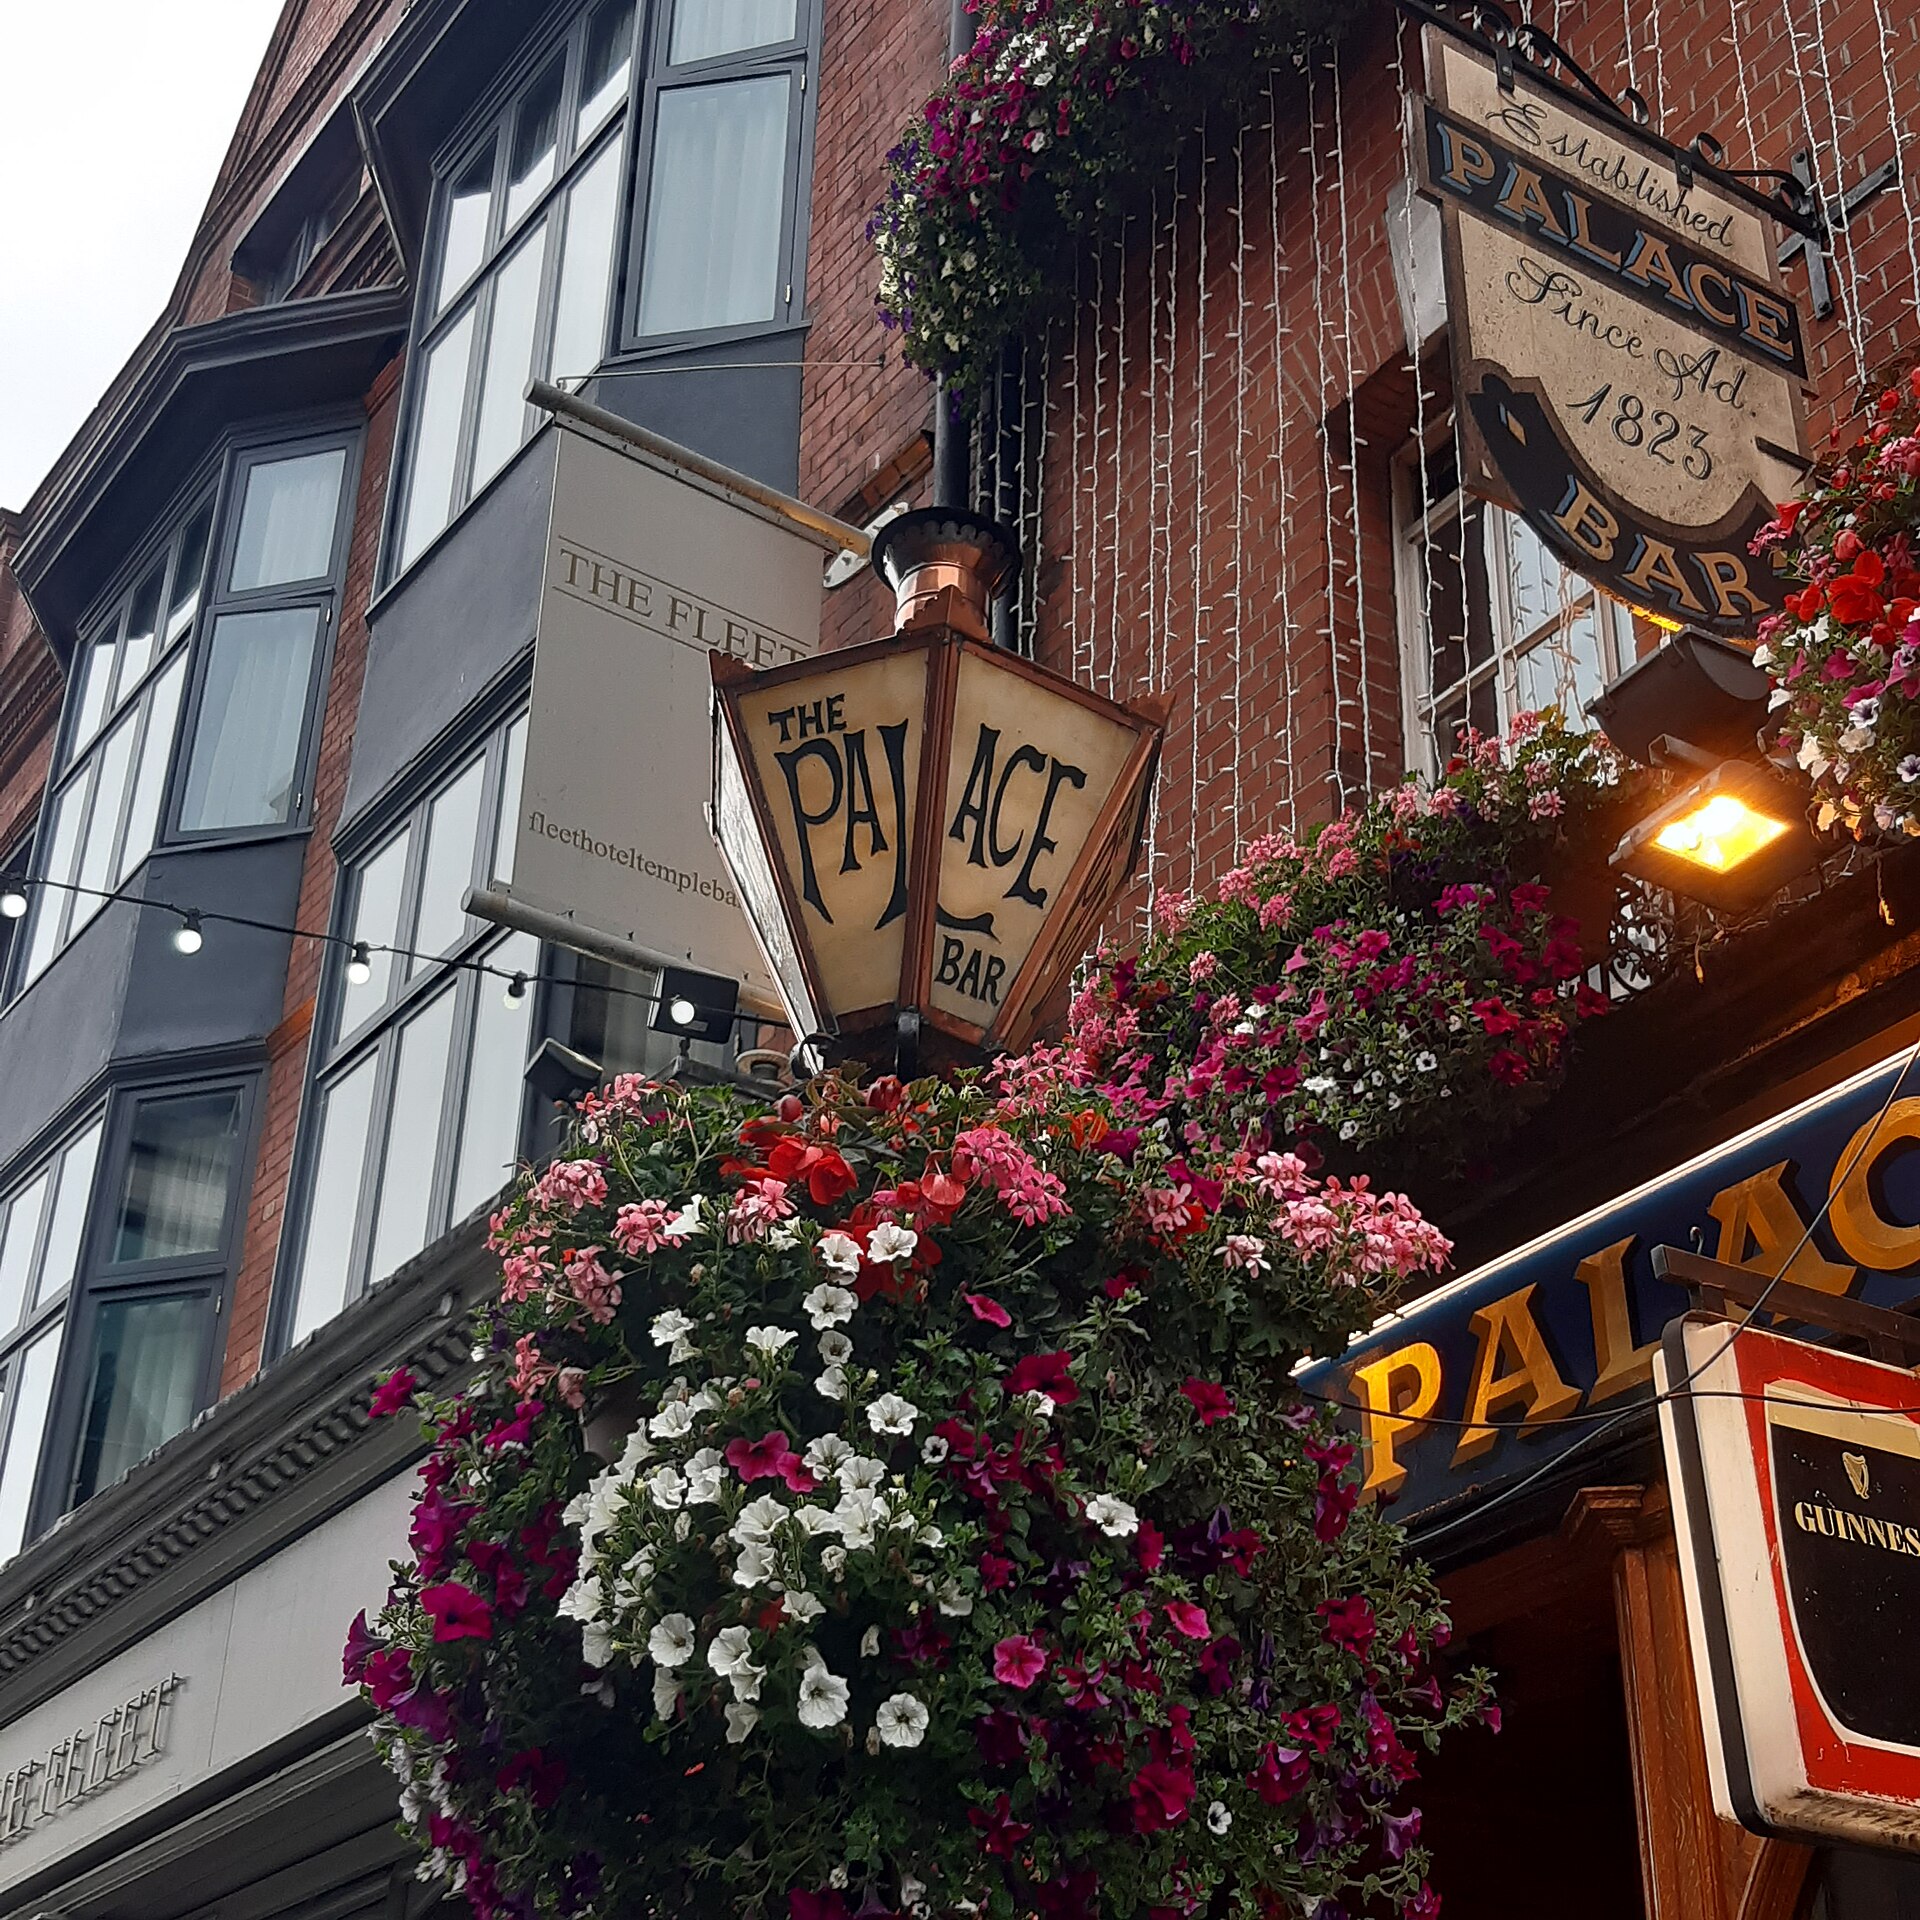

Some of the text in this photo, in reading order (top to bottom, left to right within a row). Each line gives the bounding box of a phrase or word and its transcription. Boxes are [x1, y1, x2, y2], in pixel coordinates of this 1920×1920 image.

[1486, 98, 1733, 248] Established
[1437, 121, 1793, 362] PALACE
[1505, 257, 1643, 358] Since
[1567, 383, 1713, 481] 1823
[560, 548, 653, 618] THE
[1540, 474, 1770, 624] BAR
[767, 693, 847, 743] THE
[528, 811, 741, 908] fleethoteltempleba
[774, 718, 1088, 944] PALACE
[935, 933, 1006, 1004] BAR
[1794, 1501, 1920, 1557] GUINNES
